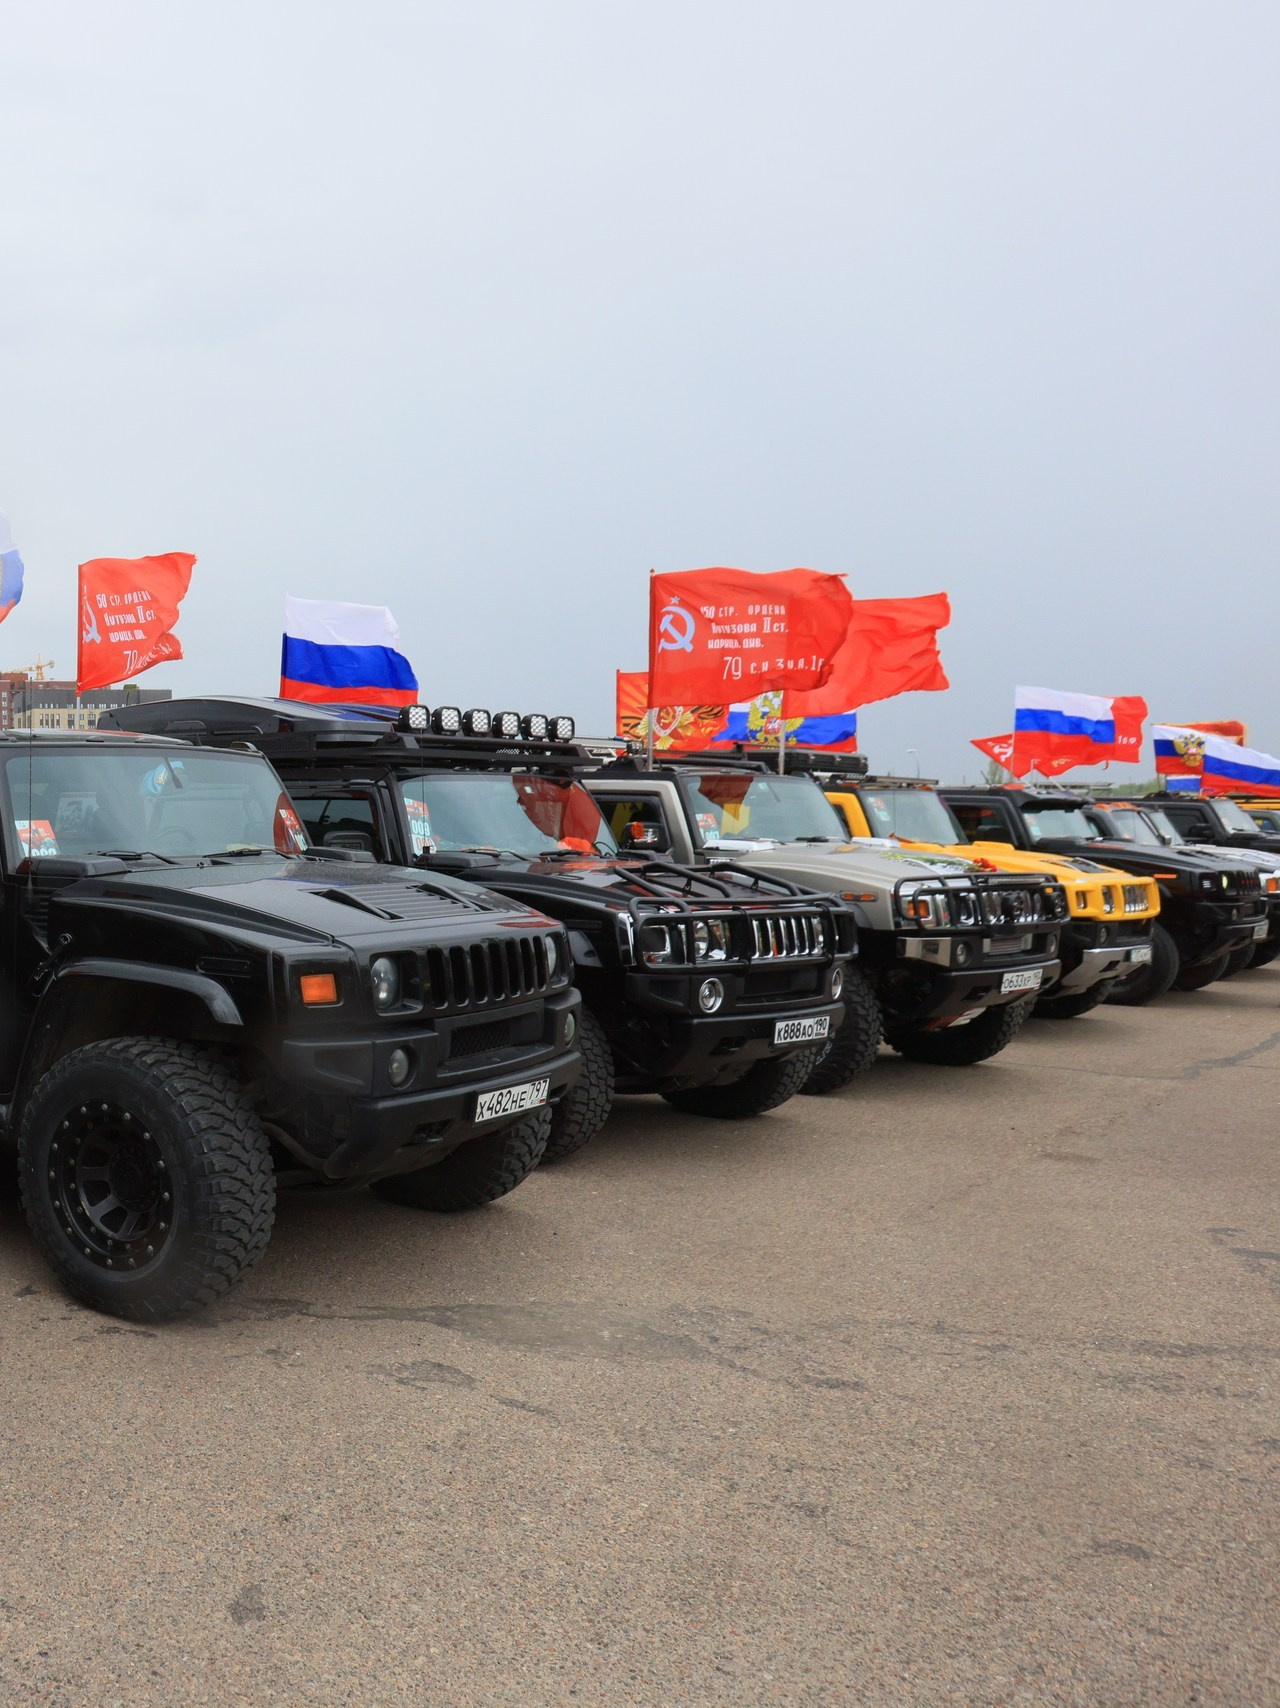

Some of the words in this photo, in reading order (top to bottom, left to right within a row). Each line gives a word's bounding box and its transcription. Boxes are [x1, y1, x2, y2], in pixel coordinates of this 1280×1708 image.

[718, 606, 738, 617] СТР.
[748, 604, 785, 615] ОРДЕНА
[723, 656, 742, 680] 79
[477, 1089, 527, 1121] Х482НЕ
[528, 1080, 548, 1101] 797
